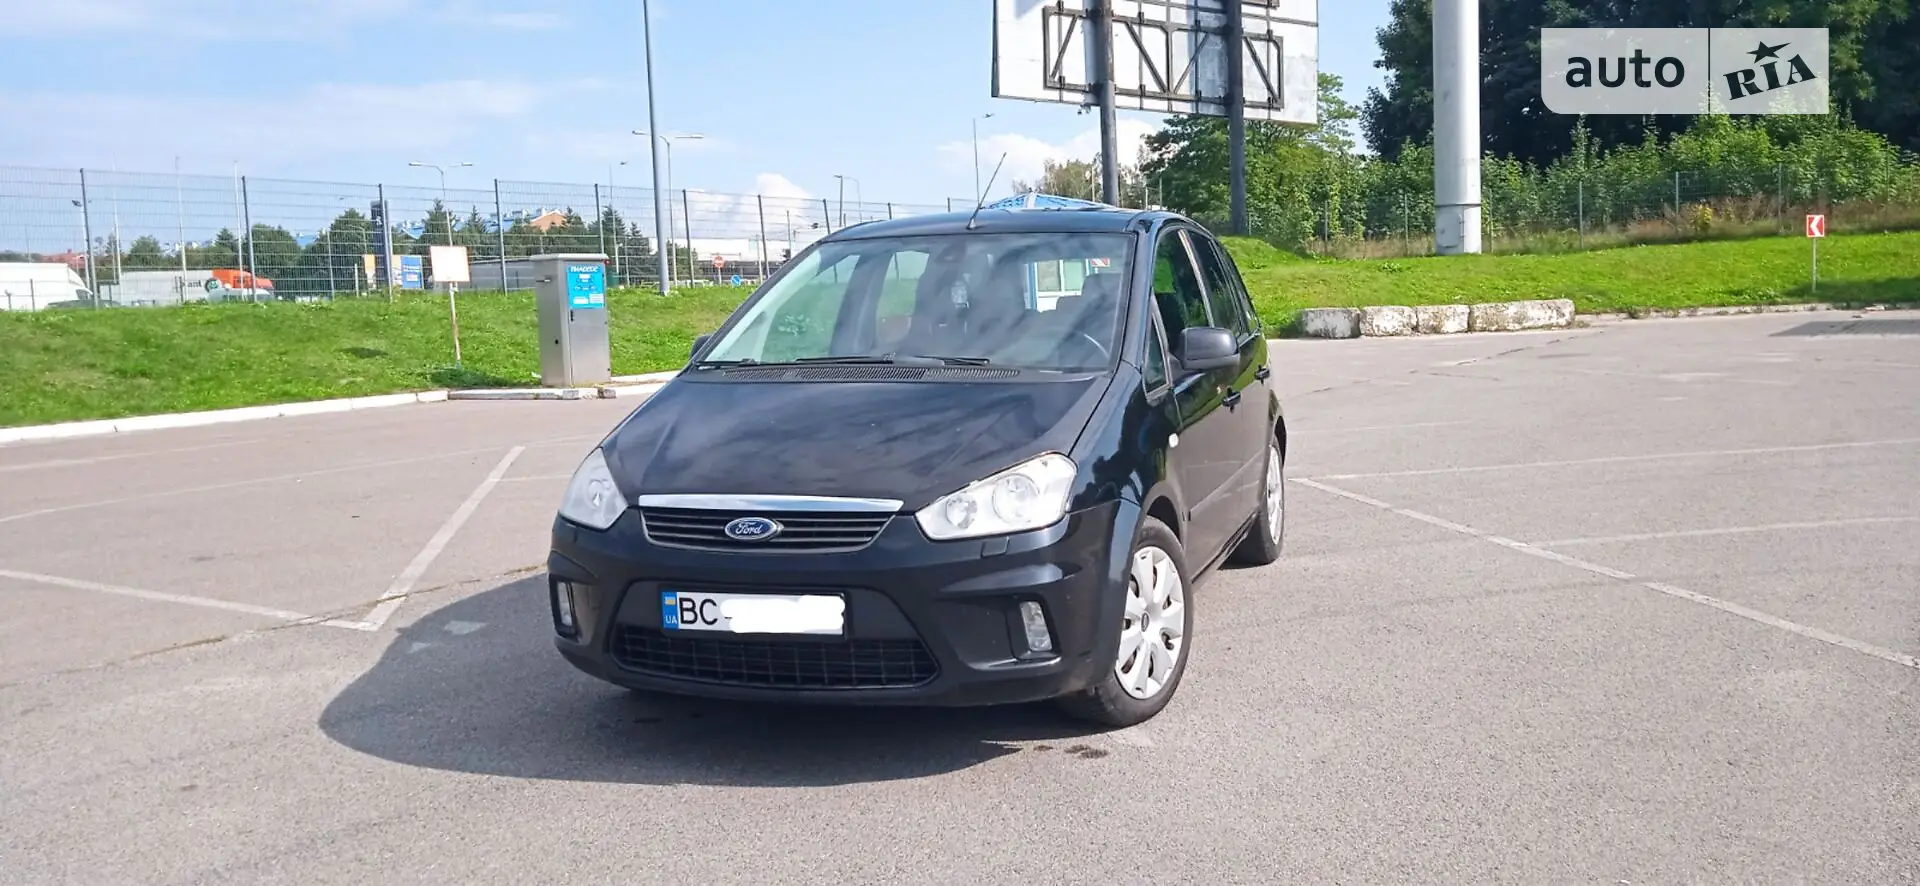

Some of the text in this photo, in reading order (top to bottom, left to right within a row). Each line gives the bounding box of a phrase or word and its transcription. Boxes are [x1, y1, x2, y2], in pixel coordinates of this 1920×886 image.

[735, 521, 763, 535] Ford
[679, 597, 718, 625] BC
[665, 615, 678, 624] UA
